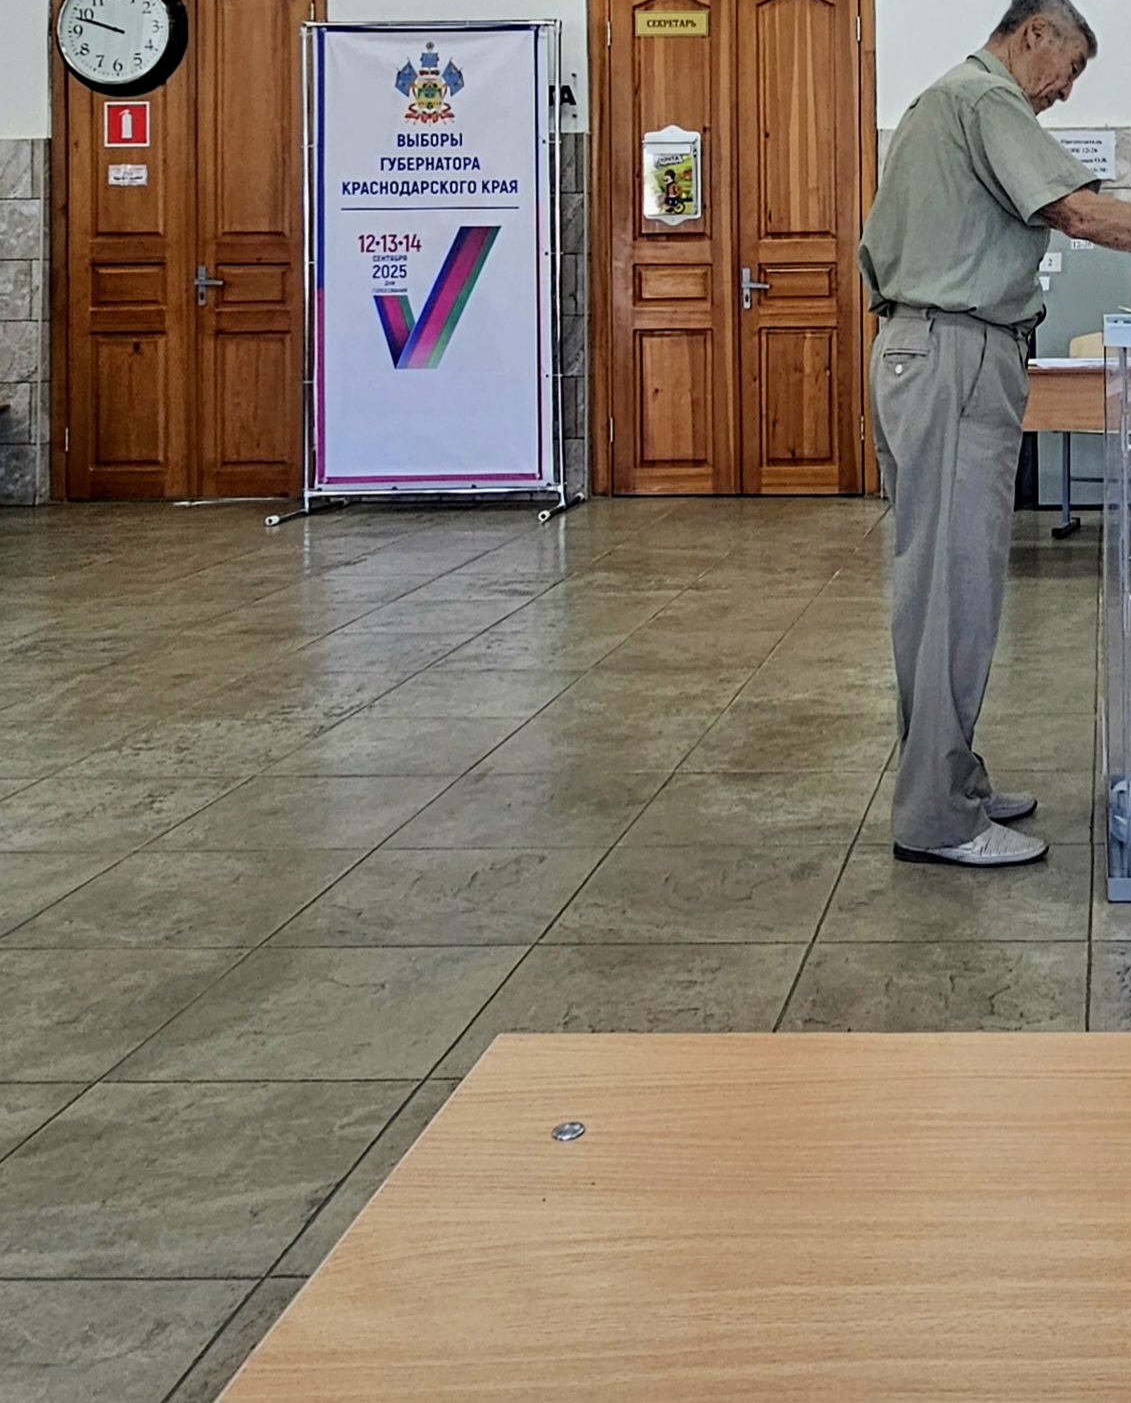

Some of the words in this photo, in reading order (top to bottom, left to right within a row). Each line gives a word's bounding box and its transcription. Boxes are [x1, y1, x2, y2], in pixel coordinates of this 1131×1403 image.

[78, 7, 95, 21] 10
[142, 1, 152, 15] 2
[151, 19, 161, 34] 3
[646, 18, 698, 29] СЕКРЕТАРЬ
[72, 24, 84, 39] 9
[79, 43, 91, 57] 8
[144, 38, 155, 51] 4
[95, 54, 106, 69] 7
[112, 58, 124, 73] 6
[133, 52, 144, 67] 5
[397, 133, 463, 148] ВЫБОРЫ
[380, 157, 481, 172] ГУБЕРНАТОРА
[342, 180, 477, 196] КРАСНОДАРСКОГО
[481, 179, 519, 194] КРАЯ
[372, 264, 408, 279] 2025
